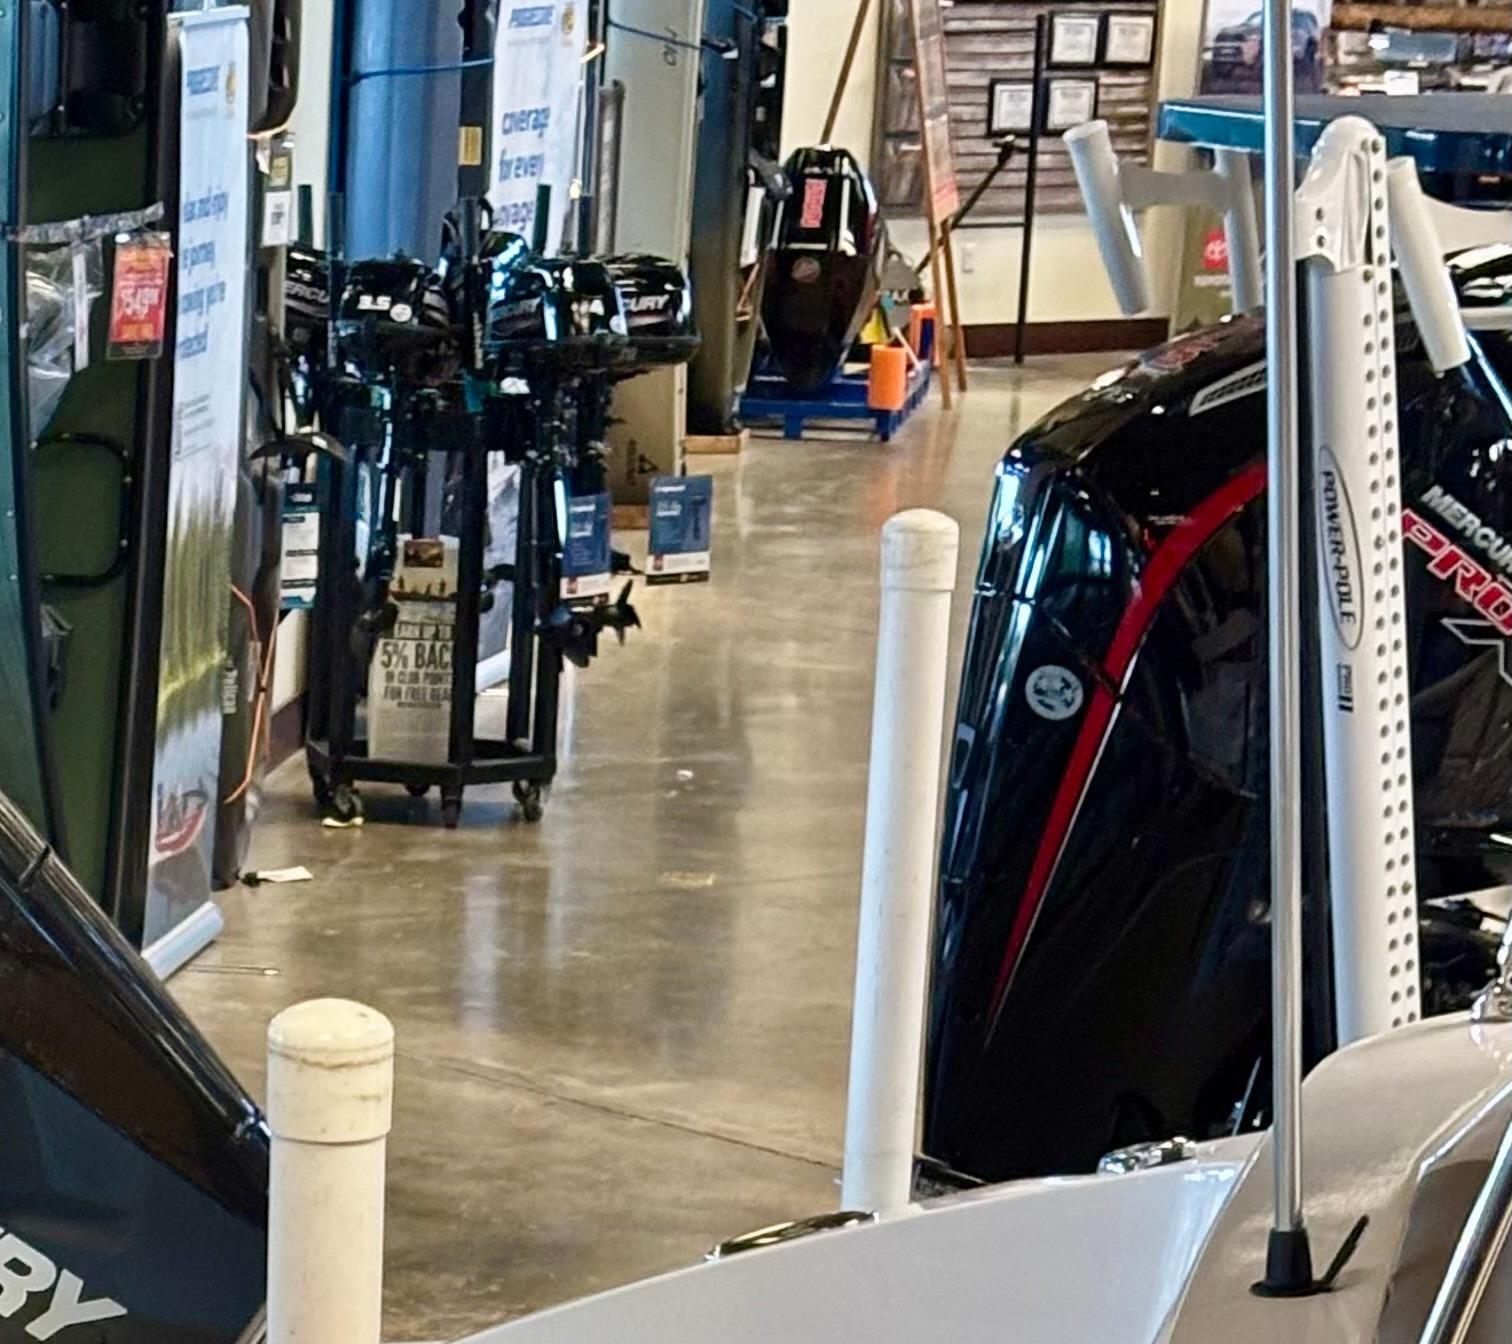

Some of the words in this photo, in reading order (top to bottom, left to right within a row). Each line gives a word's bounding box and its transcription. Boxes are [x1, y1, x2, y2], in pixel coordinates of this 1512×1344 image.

[285, 280, 330, 303] ERCU
[1322, 470, 1357, 625] POWER-POLE
[1421, 484, 1512, 573] MERCU
[381, 642, 409, 669] 5%
[414, 643, 450, 670] BAC
